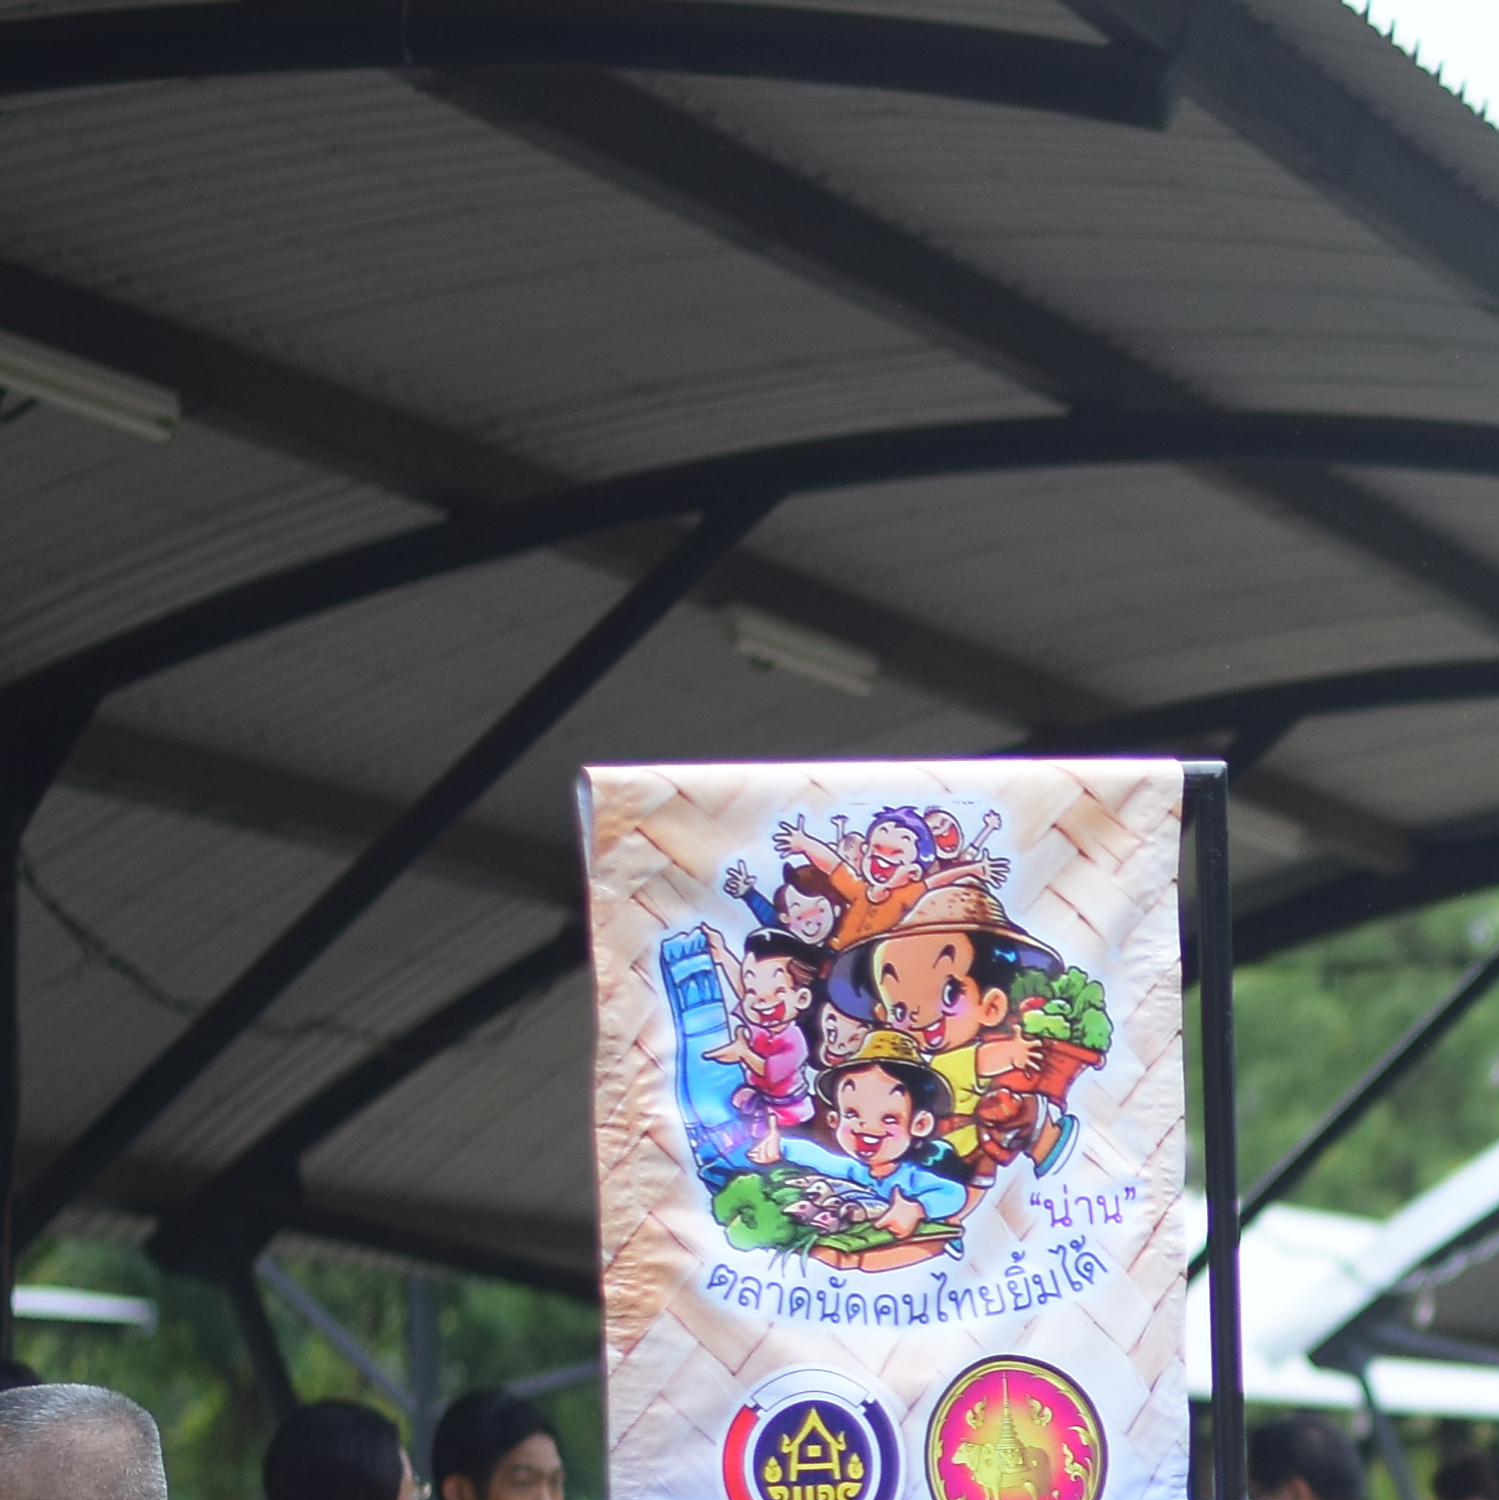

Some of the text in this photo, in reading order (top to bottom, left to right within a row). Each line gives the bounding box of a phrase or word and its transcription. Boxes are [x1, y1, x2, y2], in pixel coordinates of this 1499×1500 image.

[707, 1234, 1109, 1326] ตลาดนัดคนไทยยิ้มได้
